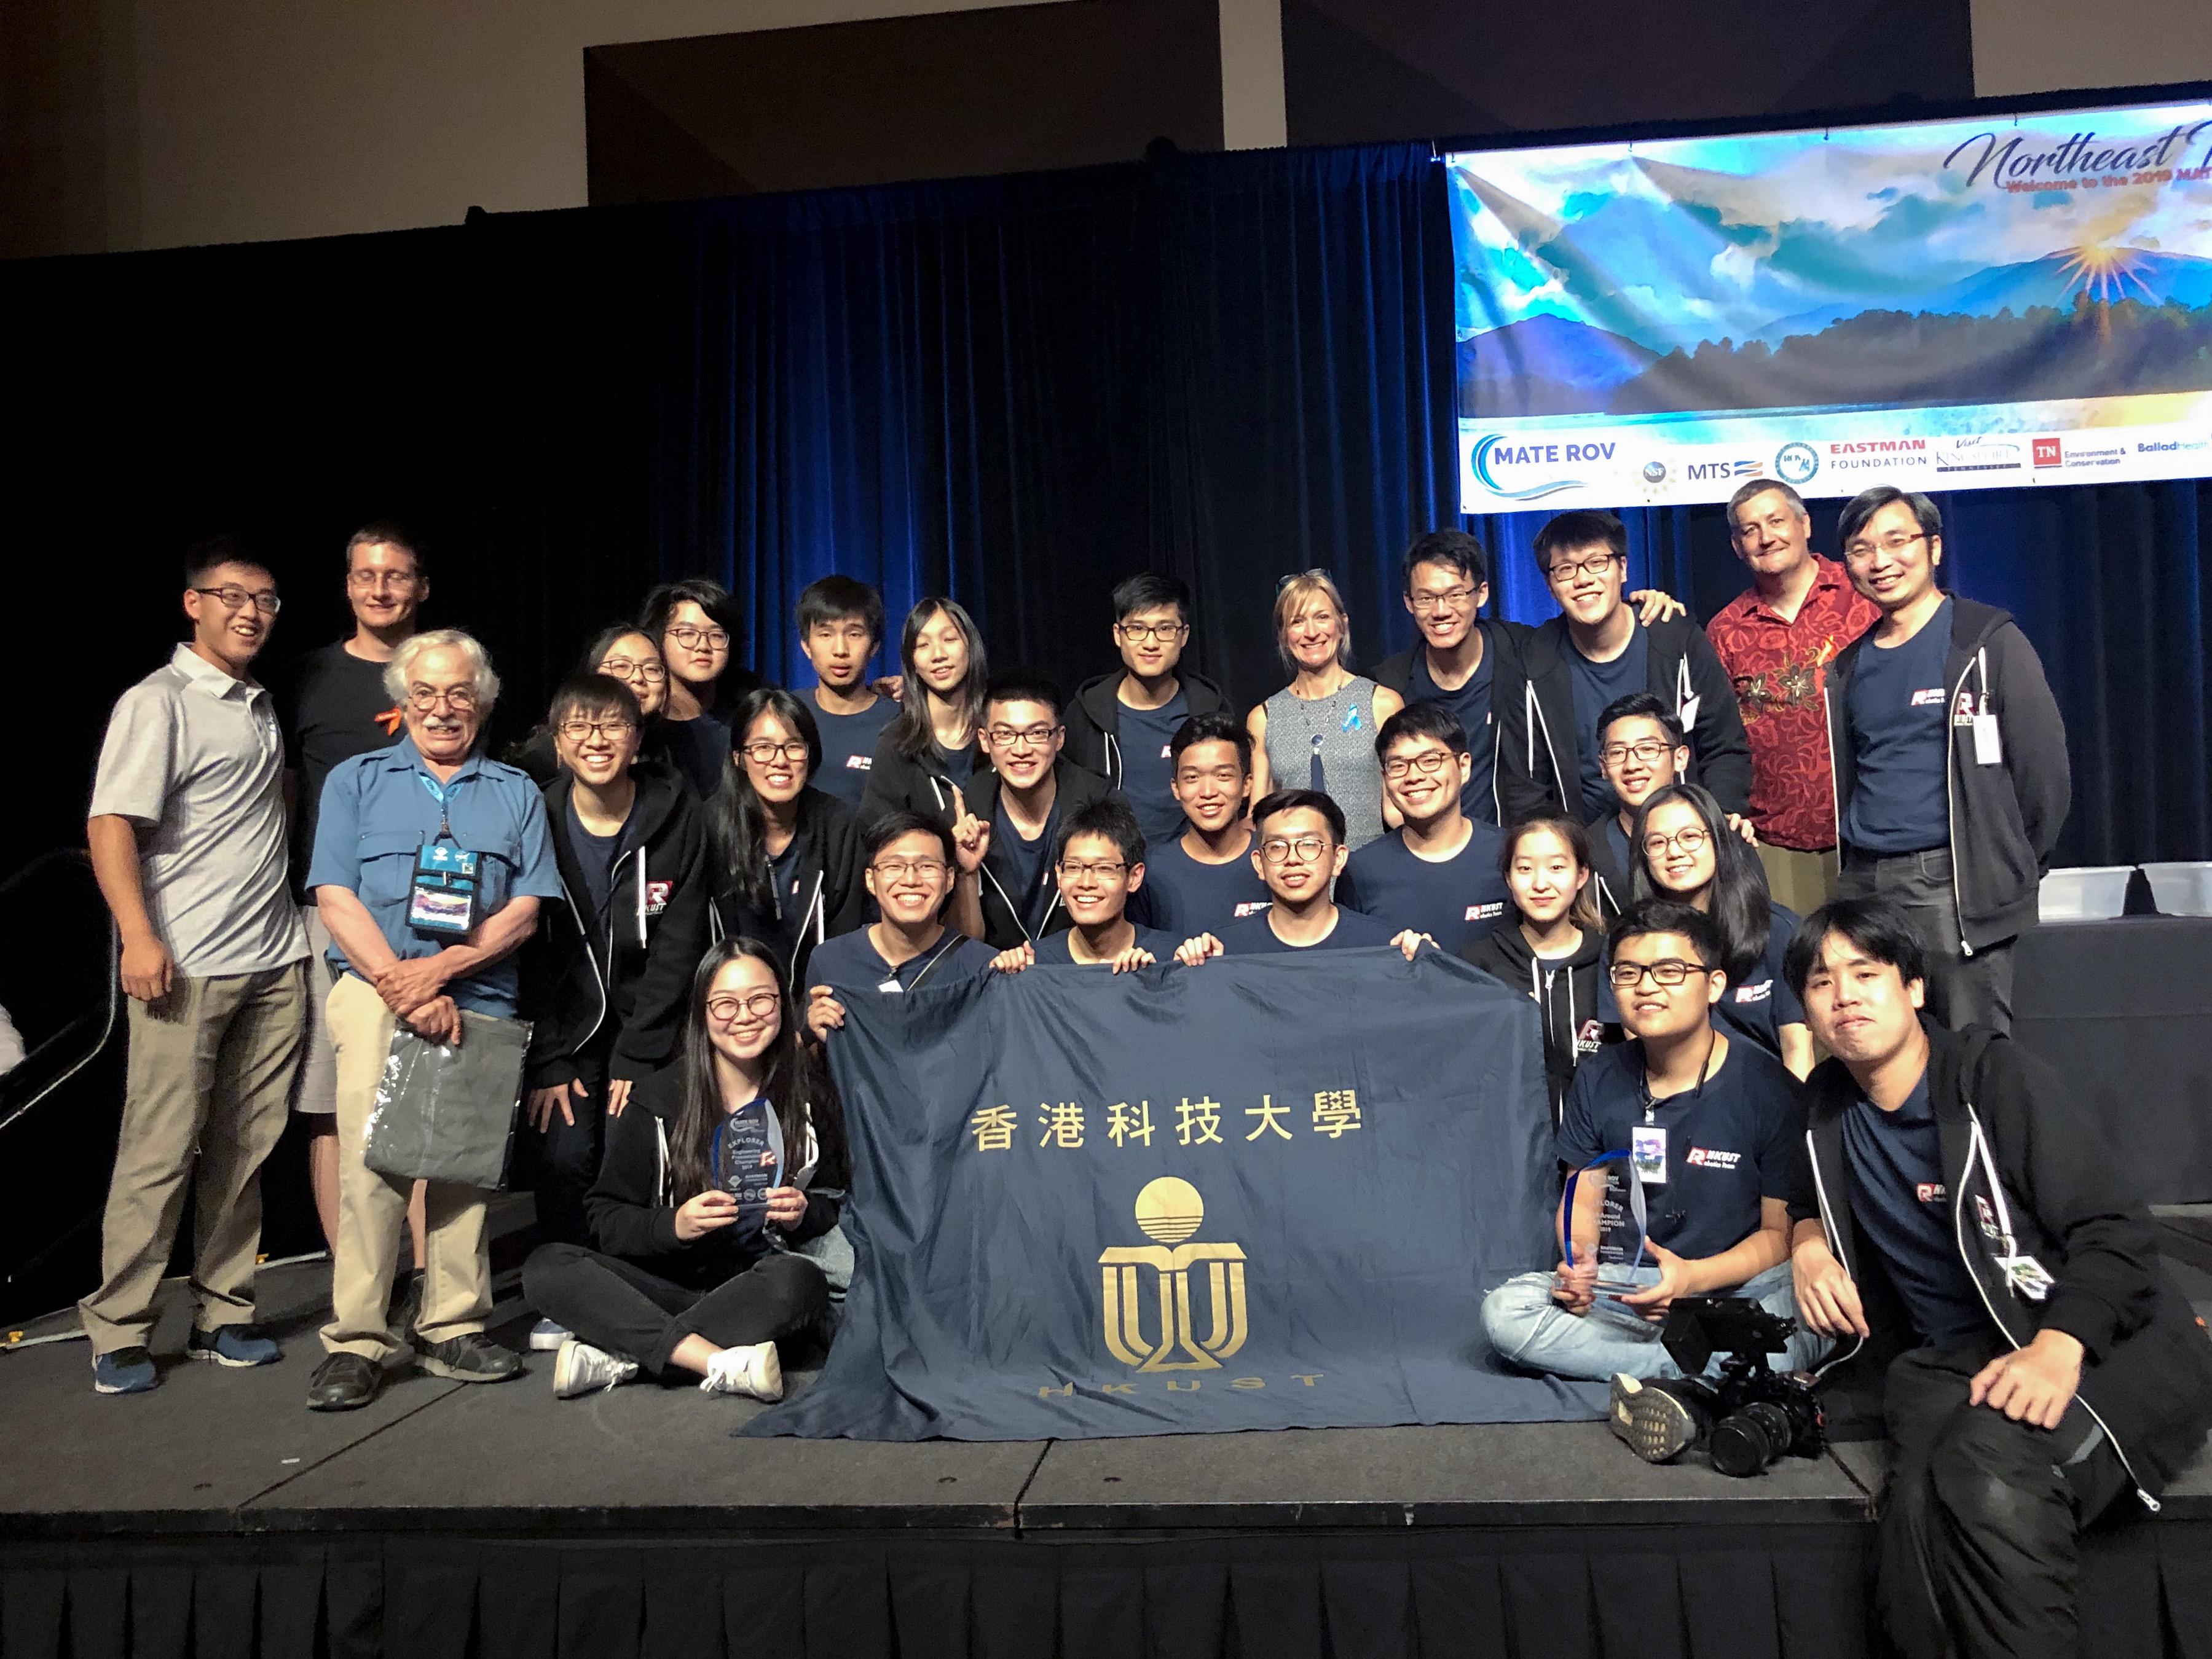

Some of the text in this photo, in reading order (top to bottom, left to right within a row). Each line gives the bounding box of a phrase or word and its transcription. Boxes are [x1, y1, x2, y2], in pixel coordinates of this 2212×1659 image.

[1943, 125, 2188, 188] Northeast
[2005, 179, 2078, 193] Welcome
[2082, 177, 2098, 189] to
[2102, 175, 2128, 187] the
[1495, 442, 1616, 465] MATE ROV
[1830, 439, 1926, 455] EASTMAN
[2036, 445, 2057, 458] TN
[2064, 447, 2126, 458] Environment &
[1687, 462, 1730, 480] MTS
[1831, 457, 1927, 469] FOUNDATION
[2065, 458, 2121, 468] Conservation
[1645, 466, 1665, 477] NSF
[971, 1089, 1361, 1152] 香港科技大學
[728, 1137, 765, 1149] EXPLORER
[1038, 1373, 1324, 1398] HKUST
